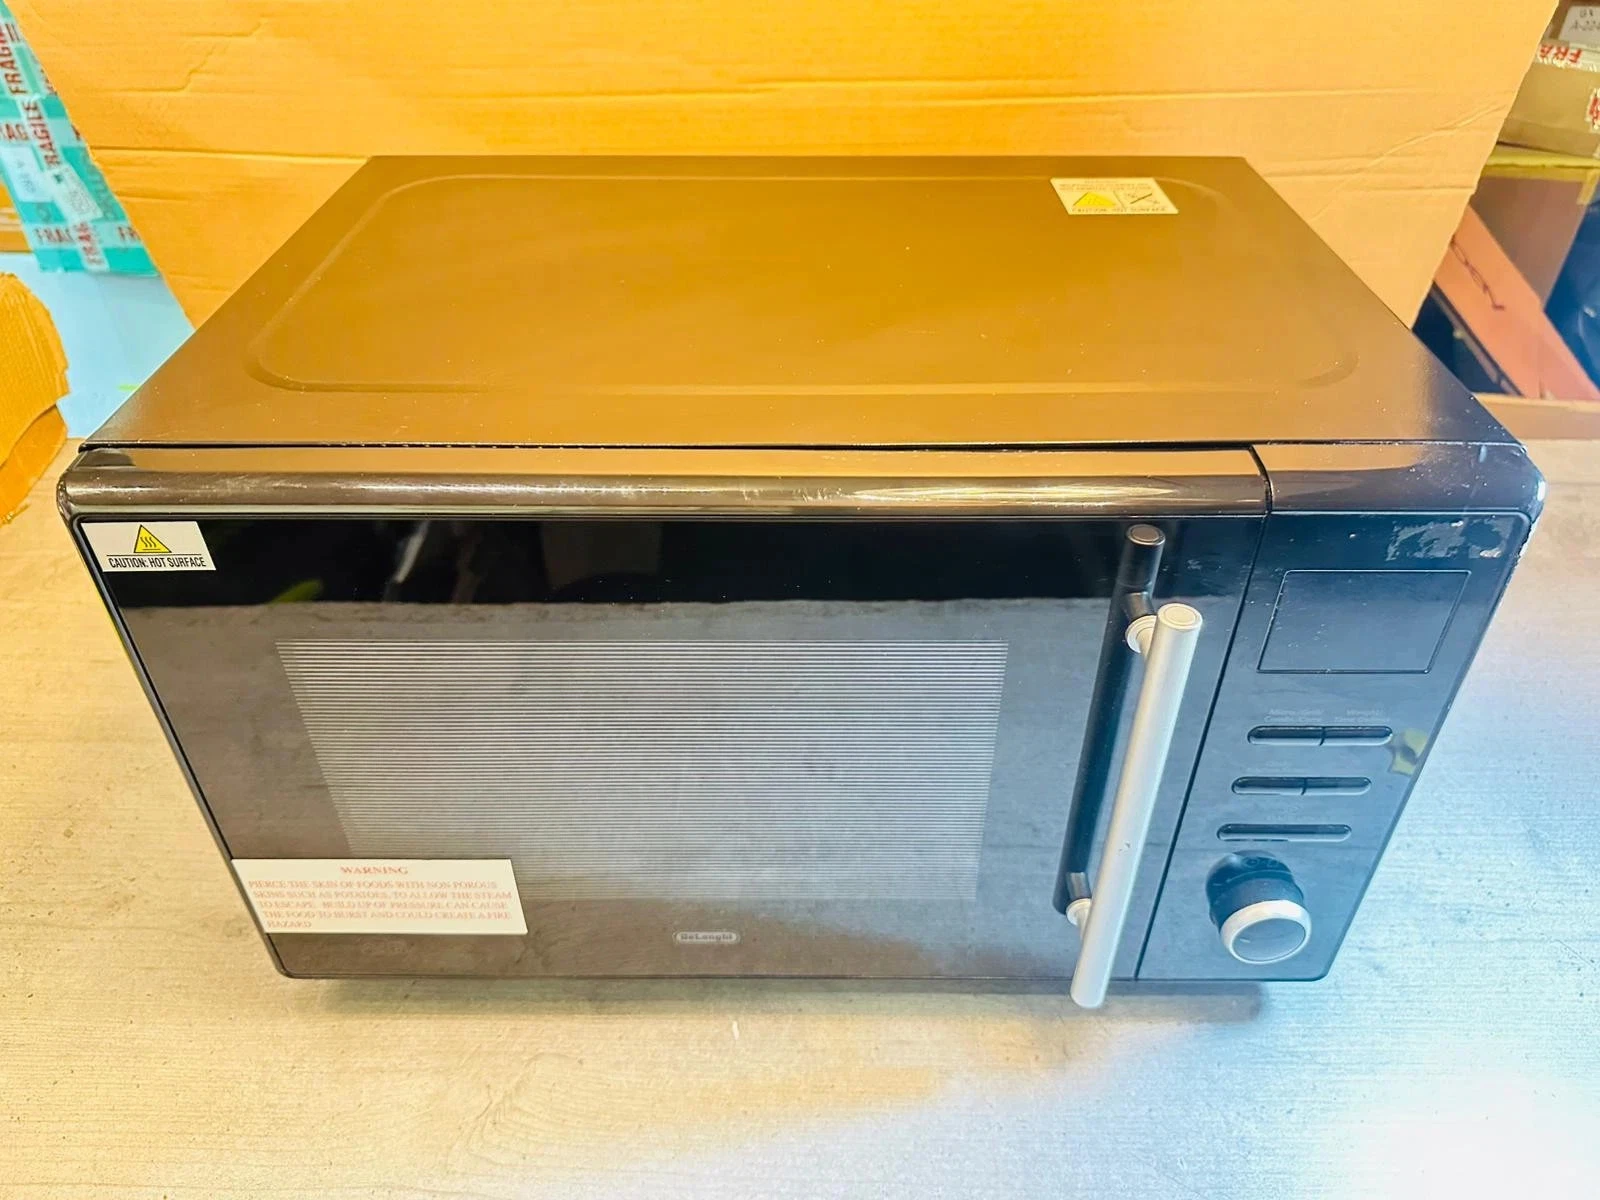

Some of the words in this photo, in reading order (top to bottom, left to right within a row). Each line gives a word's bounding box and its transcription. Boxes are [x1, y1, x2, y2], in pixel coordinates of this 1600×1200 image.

[108, 557, 148, 568] CAUTION:
[149, 557, 166, 568] HOT
[167, 556, 207, 568] SURFACE
[340, 865, 409, 875] WARNING
